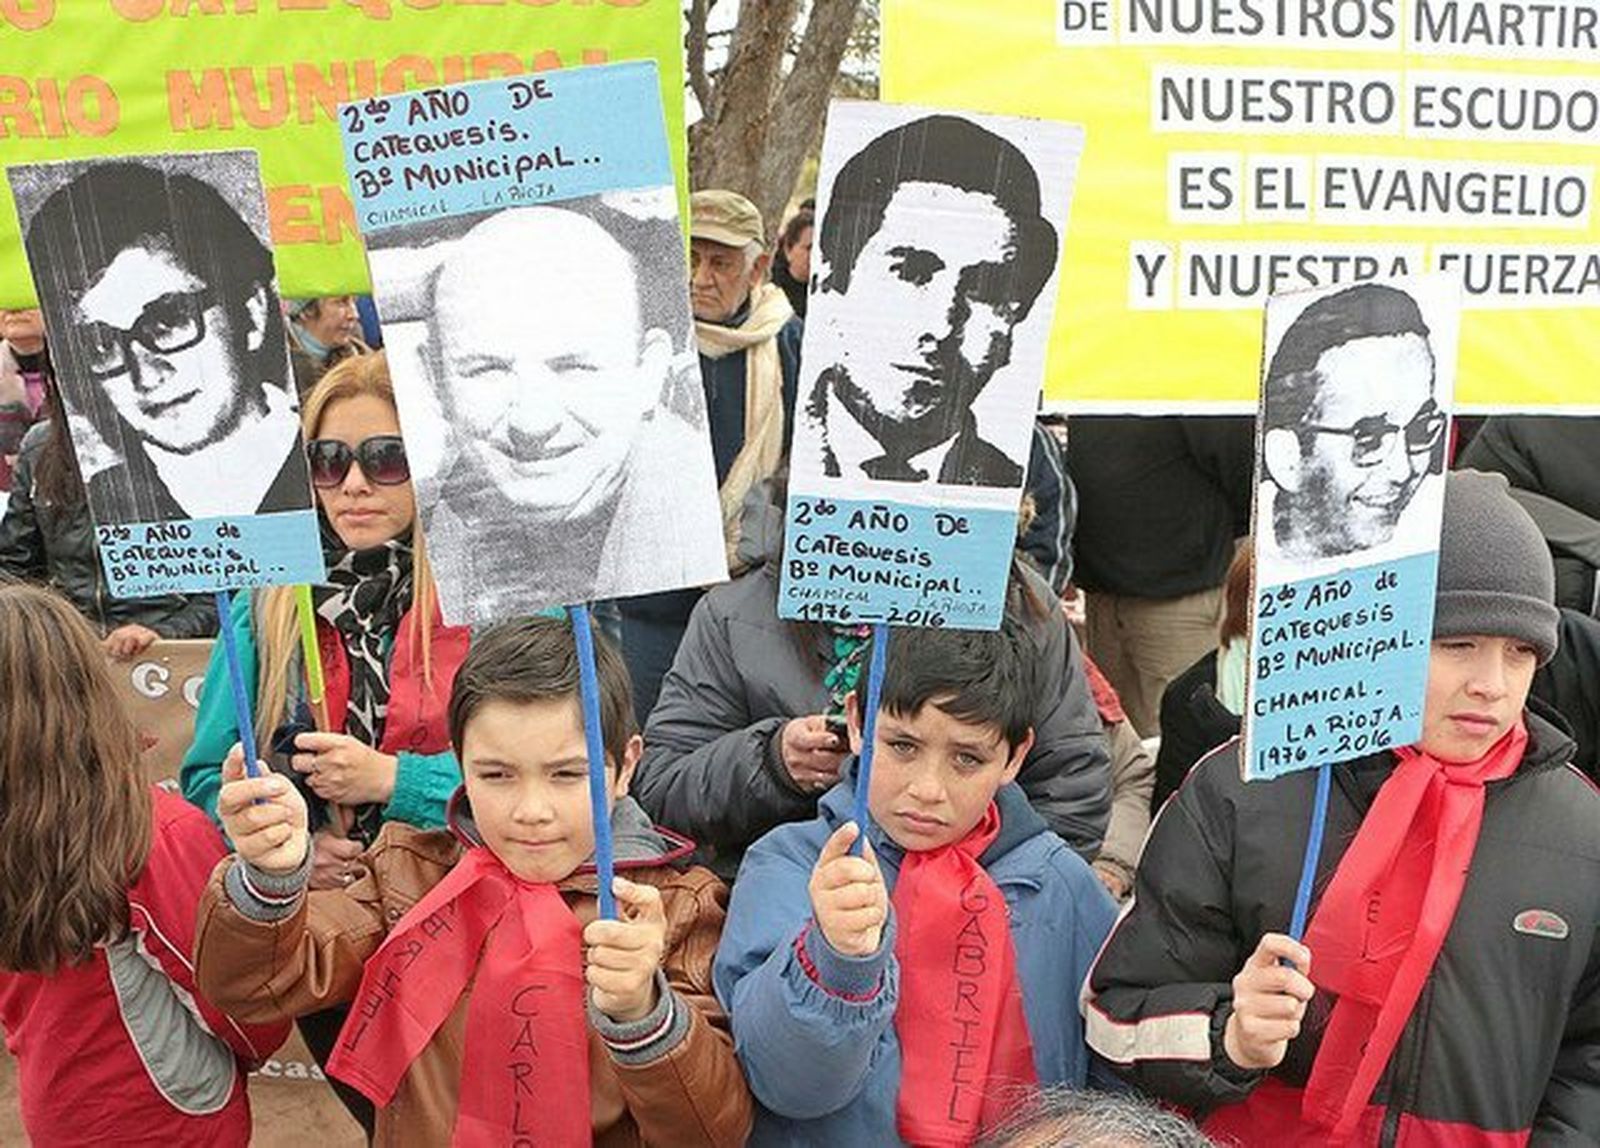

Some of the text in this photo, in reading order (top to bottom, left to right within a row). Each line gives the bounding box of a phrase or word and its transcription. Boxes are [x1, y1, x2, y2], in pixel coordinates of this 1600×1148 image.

[1064, 0, 1598, 49] DE NUESTROS MARTIR
[408, 90, 469, 125] AÑO
[508, 79, 552, 110] DE
[1161, 77, 1598, 132] NUESTRO ESCUDO
[1179, 166, 1588, 218] ES EL EVANGELIO
[1135, 253, 1167, 298] Y
[146, 524, 191, 543] AÑO
[848, 505, 909, 532] AÑO
[1374, 570, 1398, 591] de
[887, 606, 945, 627] 2016
[1287, 724, 1316, 743] LA
[1334, 729, 1391, 754] 2016
[949, 875, 988, 1123] GABRIEL
